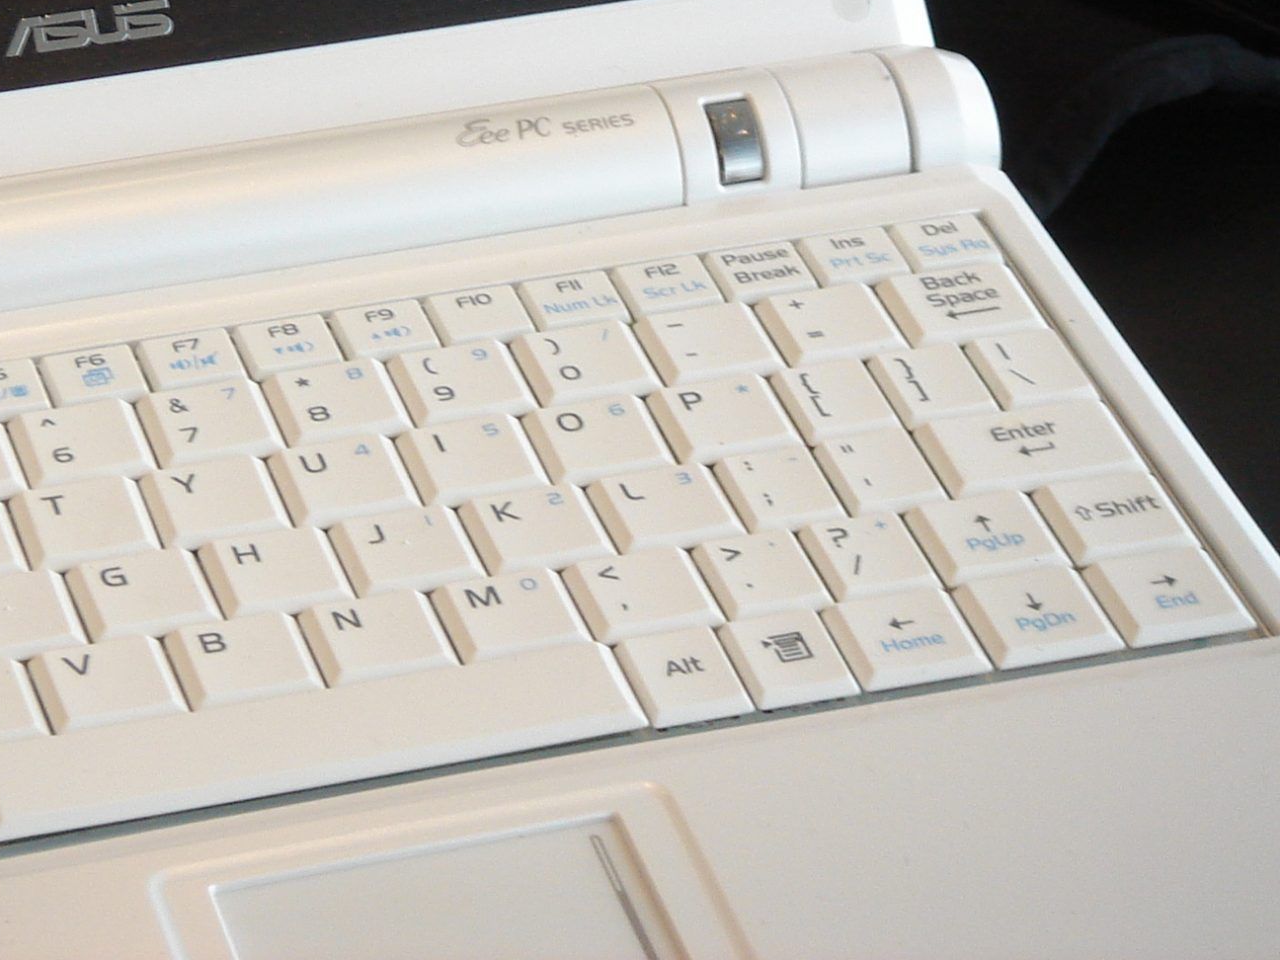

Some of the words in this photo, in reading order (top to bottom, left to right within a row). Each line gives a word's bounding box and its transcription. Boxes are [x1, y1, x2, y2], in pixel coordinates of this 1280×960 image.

[455, 117, 511, 148] Eee
[515, 116, 552, 141] PC
[561, 113, 636, 136] SERIES
[920, 220, 959, 237] Del
[830, 234, 865, 251] Ins
[721, 246, 790, 267] Pause
[830, 252, 867, 270] Prt
[869, 249, 895, 266] Sc
[642, 262, 682, 280] F12
[733, 263, 802, 286] Break
[919, 269, 984, 292] Back
[555, 278, 584, 294] F11
[453, 292, 494, 310] F10
[542, 297, 590, 317] Num
[592, 292, 618, 308] Lk
[925, 285, 1003, 311] Space
[363, 306, 396, 324] F9
[266, 322, 301, 339] F8
[171, 337, 201, 354] F7
[73, 352, 107, 370] F6
[432, 384, 456, 403] 9
[676, 390, 705, 413] P
[305, 404, 332, 423] 8
[177, 425, 201, 445] 7
[989, 419, 1058, 444] Enter
[52, 445, 75, 464] 6
[298, 452, 329, 475] U
[170, 472, 197, 496] Y
[618, 481, 646, 501] L
[40, 493, 66, 517] T
[488, 499, 524, 524] K
[1094, 493, 1162, 520] Shift
[367, 522, 388, 546] J
[965, 530, 1027, 554] PgUp
[230, 542, 264, 566] H
[98, 565, 131, 589] G
[462, 584, 504, 610] M
[1154, 591, 1202, 611] End
[330, 606, 365, 632] N
[1014, 609, 1078, 633] PgDn
[196, 631, 229, 655] B
[880, 631, 947, 655] Home
[60, 652, 93, 677] V
[665, 655, 707, 678] Alt
